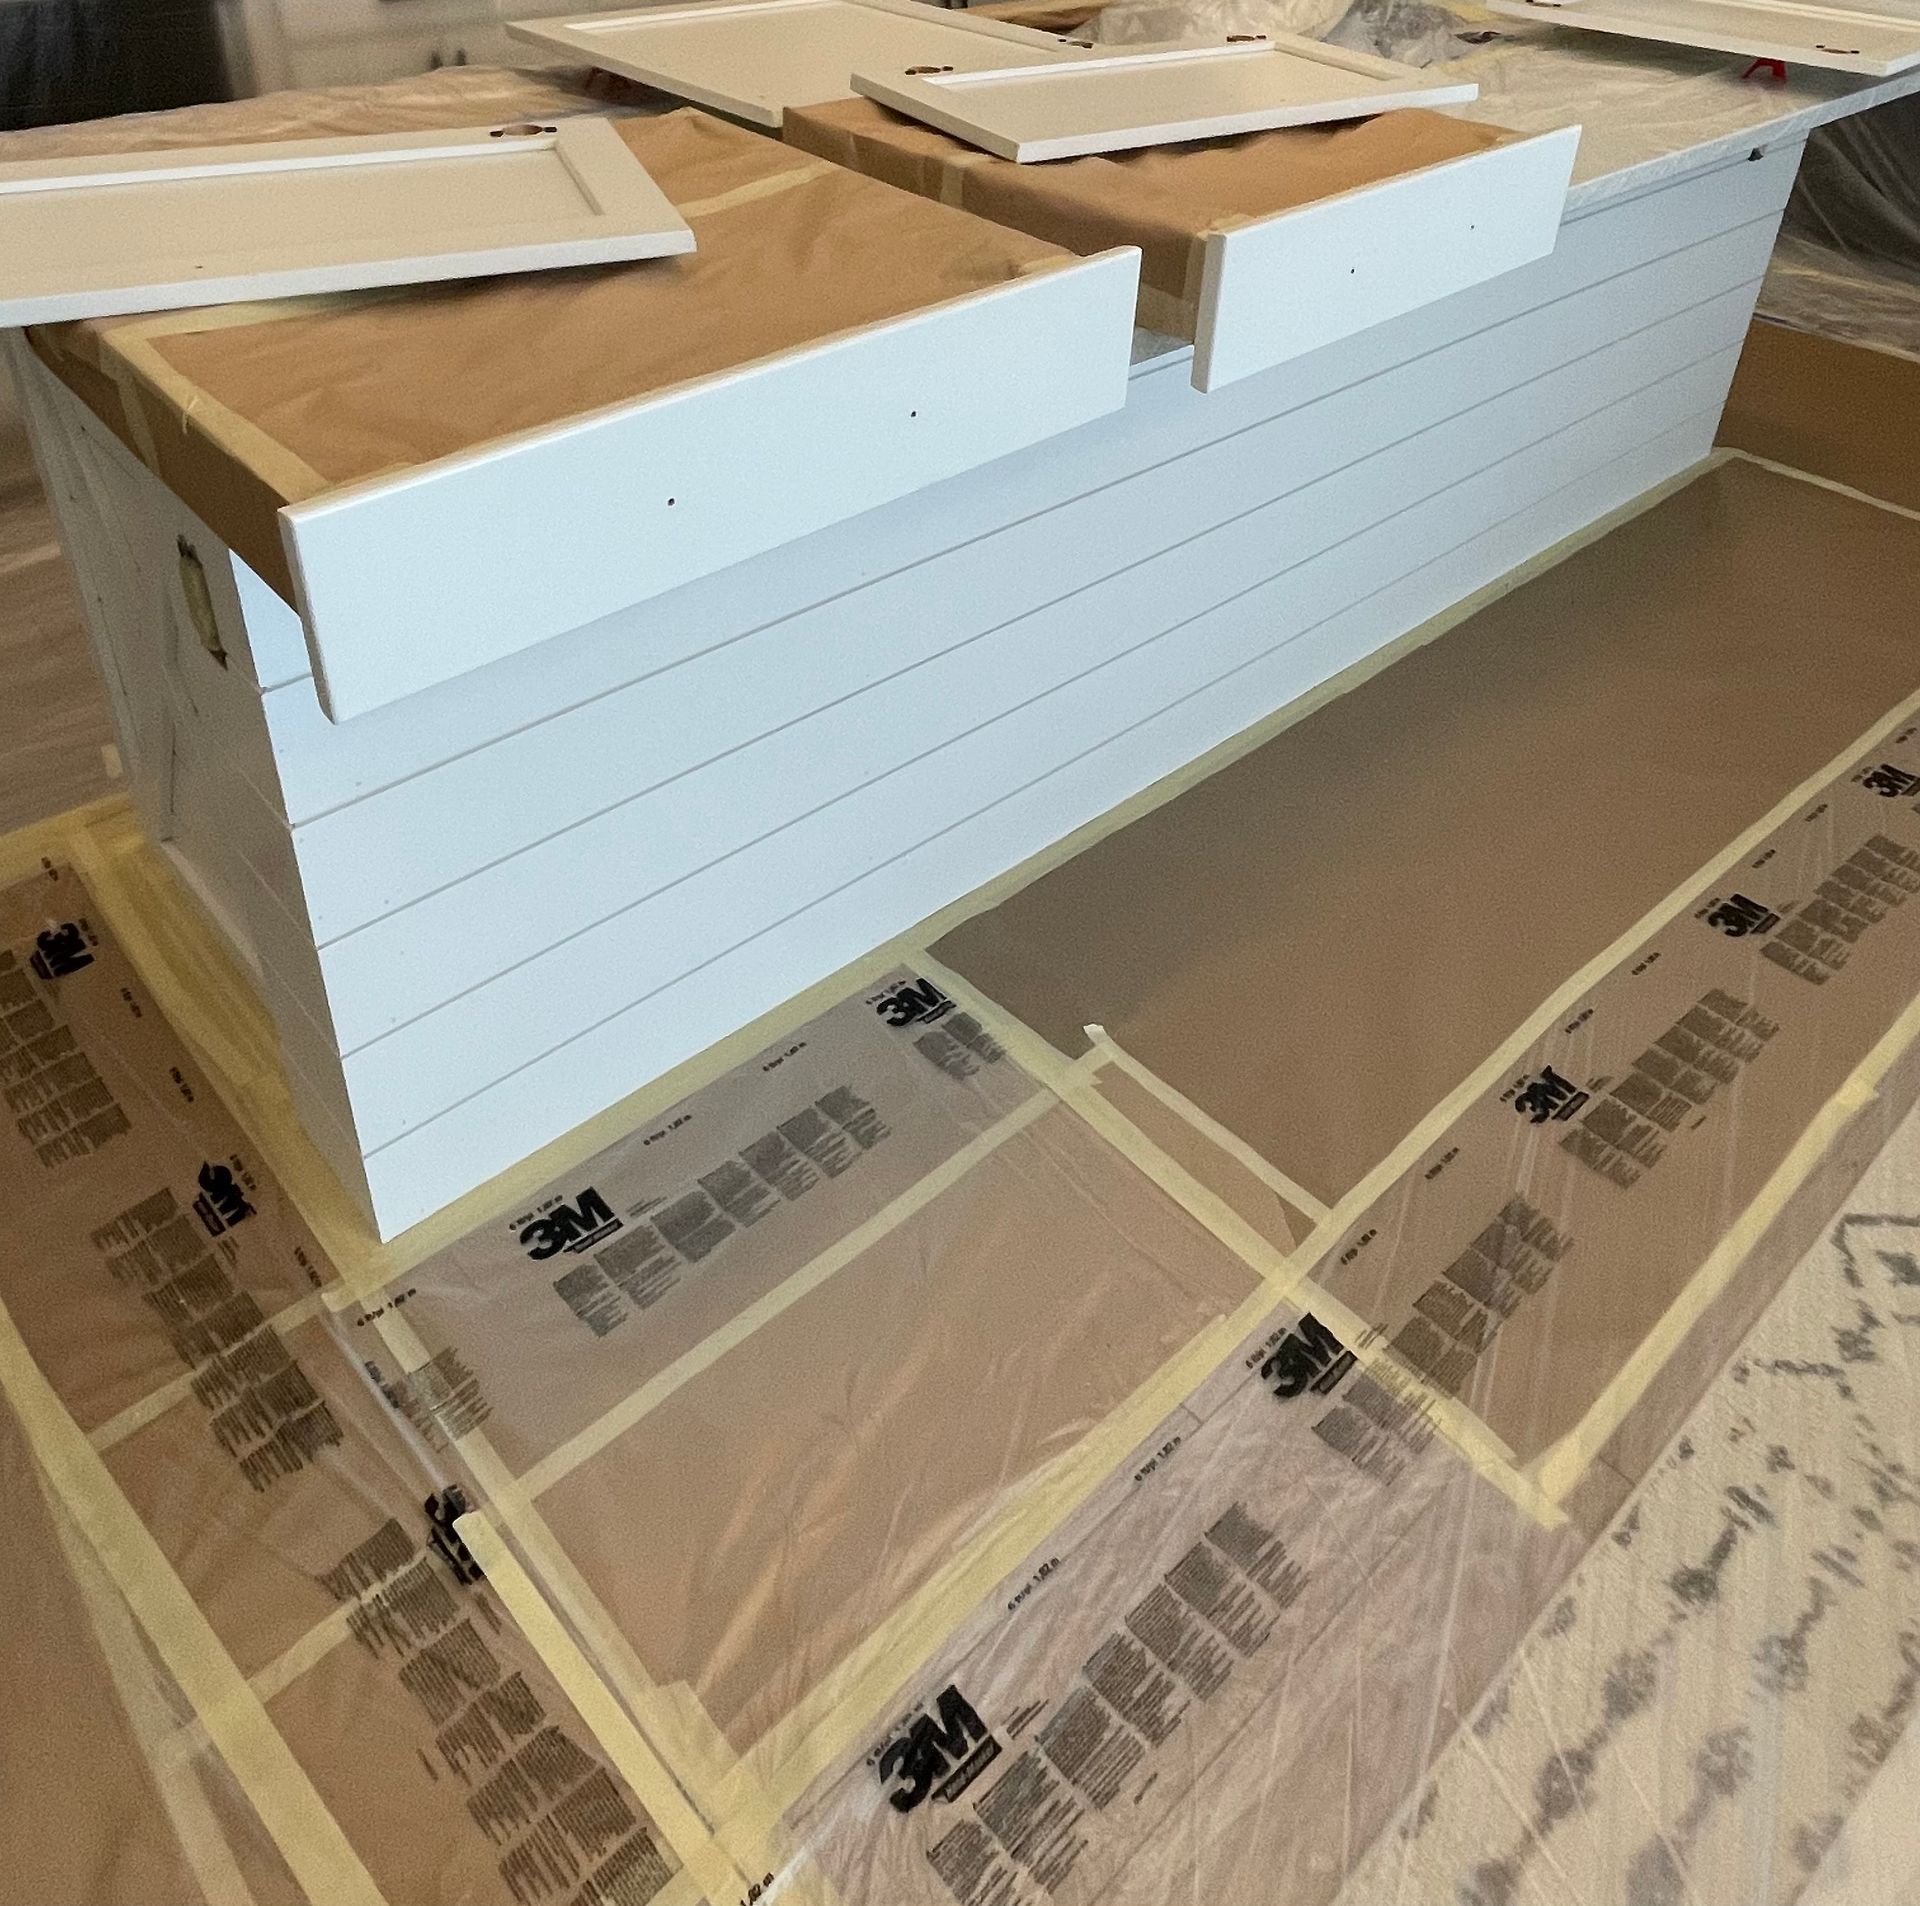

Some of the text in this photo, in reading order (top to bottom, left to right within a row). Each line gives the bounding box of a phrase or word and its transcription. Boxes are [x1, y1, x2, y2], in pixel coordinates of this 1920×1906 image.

[1863, 763, 1916, 797] 3M
[1708, 893, 1768, 937] 3M
[37, 922, 96, 977] 3M
[876, 977, 947, 1027] 3M
[1515, 1064, 1577, 1124] 3M
[519, 1186, 616, 1261] 3M
[1260, 1312, 1345, 1399] 3M
[879, 1684, 988, 1814] 3M
